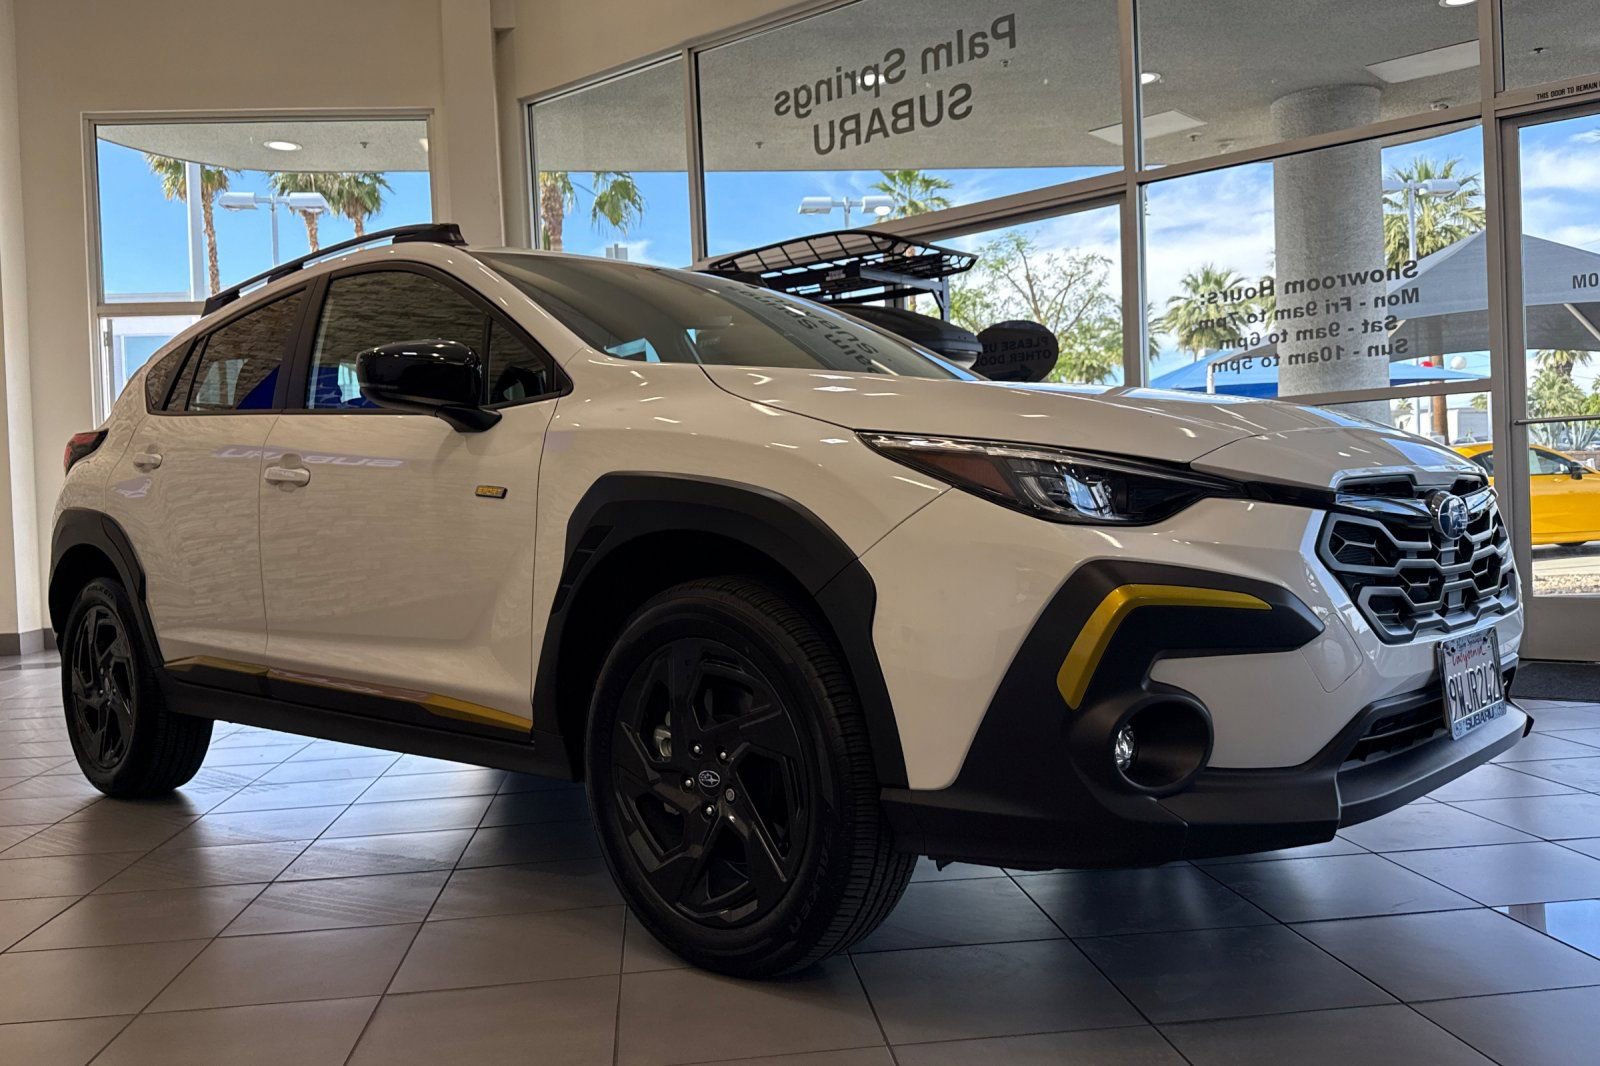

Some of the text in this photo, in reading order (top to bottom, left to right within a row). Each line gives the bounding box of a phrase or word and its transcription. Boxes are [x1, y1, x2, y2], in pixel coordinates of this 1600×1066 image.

[1536, 92, 1549, 100] THIS
[1551, 89, 1566, 97] DOOR
[1576, 82, 1598, 91] REMAIN
[1448, 659, 1503, 722] 9WJR242
[1465, 705, 1495, 731] SUBARU
